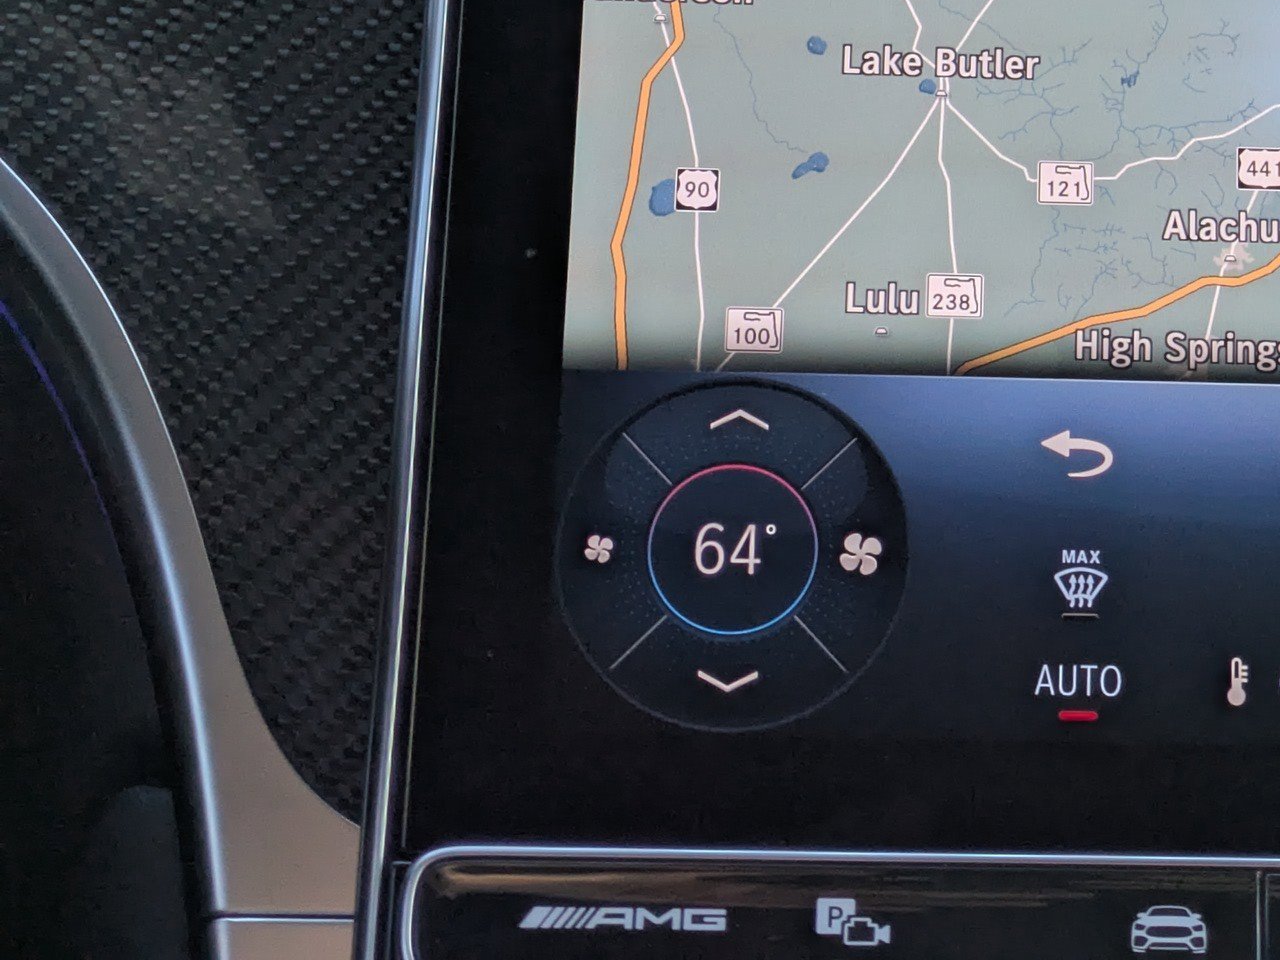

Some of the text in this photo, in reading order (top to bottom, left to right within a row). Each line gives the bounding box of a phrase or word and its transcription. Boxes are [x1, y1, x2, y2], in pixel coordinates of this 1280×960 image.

[841, 45, 1040, 80] Lake Butler
[684, 182, 710, 198] 90
[1047, 181, 1082, 198] 121
[845, 282, 920, 317] Lulu
[932, 293, 970, 311] 238
[733, 327, 770, 344] 100
[1075, 328, 1153, 369] High
[1062, 550, 1100, 564] MAX
[1035, 664, 1121, 697] AUTO
